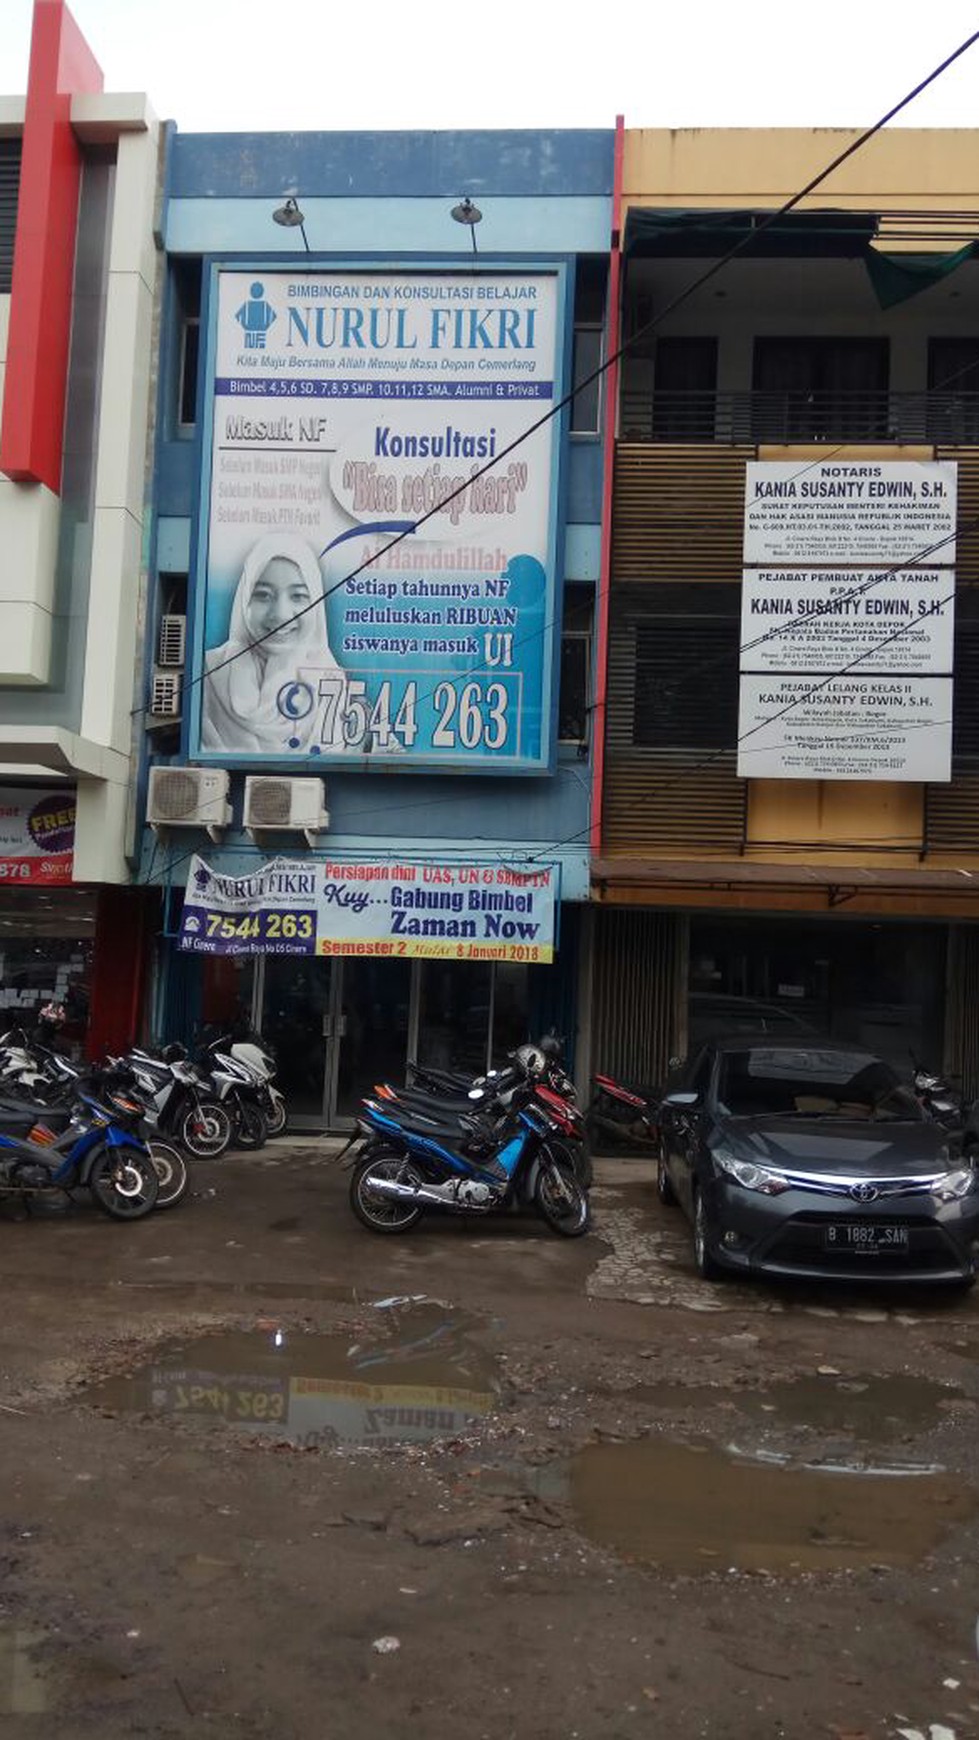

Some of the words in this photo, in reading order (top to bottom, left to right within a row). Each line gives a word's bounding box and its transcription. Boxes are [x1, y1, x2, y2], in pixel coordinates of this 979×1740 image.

[288, 284, 359, 298] BIMBINGAN
[363, 285, 390, 299] DAN
[394, 286, 473, 299] KONSULTASI
[477, 286, 537, 299] BELAJAR
[286, 306, 418, 349] NURUL
[428, 307, 537, 349] FIKRI
[236, 356, 257, 366] Kita
[261, 356, 286, 370] Maju
[288, 356, 335, 369] Bersama
[337, 357, 366, 369] Allah
[367, 357, 407, 371] Menuju
[409, 358, 437, 370] Masa
[441, 358, 474, 371] Depan
[230, 380, 267, 393] Bimbel
[454, 384, 492, 396] Alumni
[496, 384, 504, 396] &
[508, 384, 540, 396] Privat
[225, 415, 294, 441] Masuk
[299, 416, 327, 442] NF
[374, 426, 496, 458] Konsultasi
[821, 467, 882, 477] NOTARIS
[401, 463, 466, 526] setiap
[755, 481, 797, 498] KANIA
[800, 481, 864, 498] SUSANTY
[868, 481, 916, 501] EDWIN,
[921, 481, 947, 498] S.H.
[387, 546, 508, 571] Hamdulillah
[345, 577, 398, 599] Setiap
[402, 579, 480, 600] tahunnya
[485, 579, 509, 597] NF
[758, 573, 808, 581] PEJABAT
[811, 573, 864, 582] PEMBUAT
[901, 574, 939, 582] TANAH
[344, 607, 441, 624] meluluskan
[446, 607, 517, 625] RIBUAN
[751, 598, 793, 615] KANIA
[797, 599, 861, 615] SUSANTY
[865, 599, 913, 619] EDWIN,
[918, 599, 945, 616] S.H.
[343, 633, 418, 655] siswanya
[423, 635, 478, 654] masuk
[484, 632, 514, 667] UI
[828, 684, 868, 693] LELANG
[871, 684, 903, 693] KELAS
[759, 694, 796, 704] KANIA
[800, 694, 856, 705] SUSANTY
[860, 695, 906, 707] EDWIN,
[909, 697, 933, 706] S.H.
[318, 678, 418, 747] 7544
[432, 680, 508, 749] 263
[268, 874, 316, 894] FIKRI
[325, 862, 389, 882] Persiapan
[423, 866, 454, 887] UAS,
[459, 868, 479, 884] UN
[483, 868, 495, 885] &
[391, 885, 464, 912] Gabung
[468, 889, 533, 913] Bimbel
[205, 914, 260, 939] 7544
[265, 913, 312, 938] 263
[391, 910, 476, 937] Zaman
[483, 913, 541, 940] Now
[322, 939, 394, 954] Semester
[397, 940, 407, 955] 2
[456, 943, 464, 957] 8
[467, 944, 506, 958] Januari
[509, 945, 539, 960] 2018
